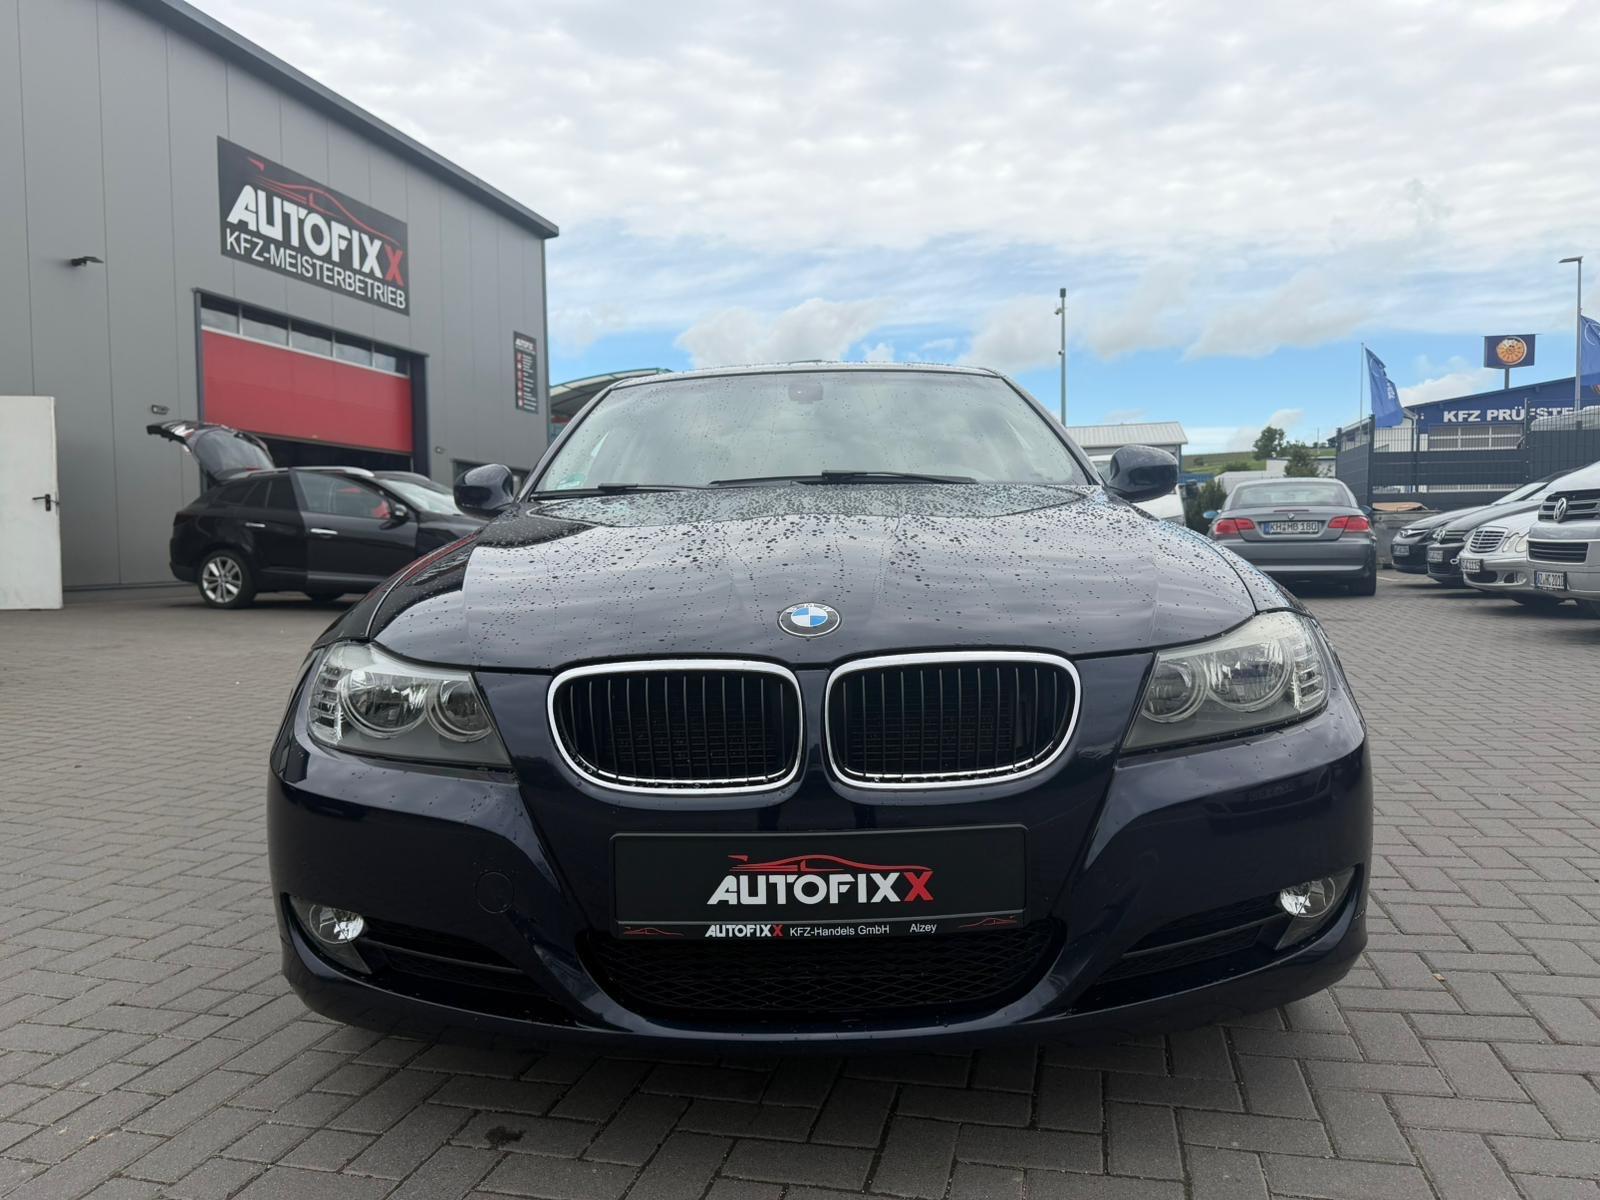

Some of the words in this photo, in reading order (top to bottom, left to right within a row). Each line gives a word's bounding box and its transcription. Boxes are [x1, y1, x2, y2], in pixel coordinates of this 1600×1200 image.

[226, 185, 404, 287] AUTOFIXX
[226, 228, 406, 309] KFZ-MEISTERBETRIEB
[1443, 411, 1481, 423] KFZ
[706, 871, 935, 905] AUTOFIXX
[704, 924, 784, 938] AUTOFIXX
[789, 925, 855, 937] KFZ-Handels
[858, 925, 890, 935] GmbH
[909, 923, 937, 934] Alzey
